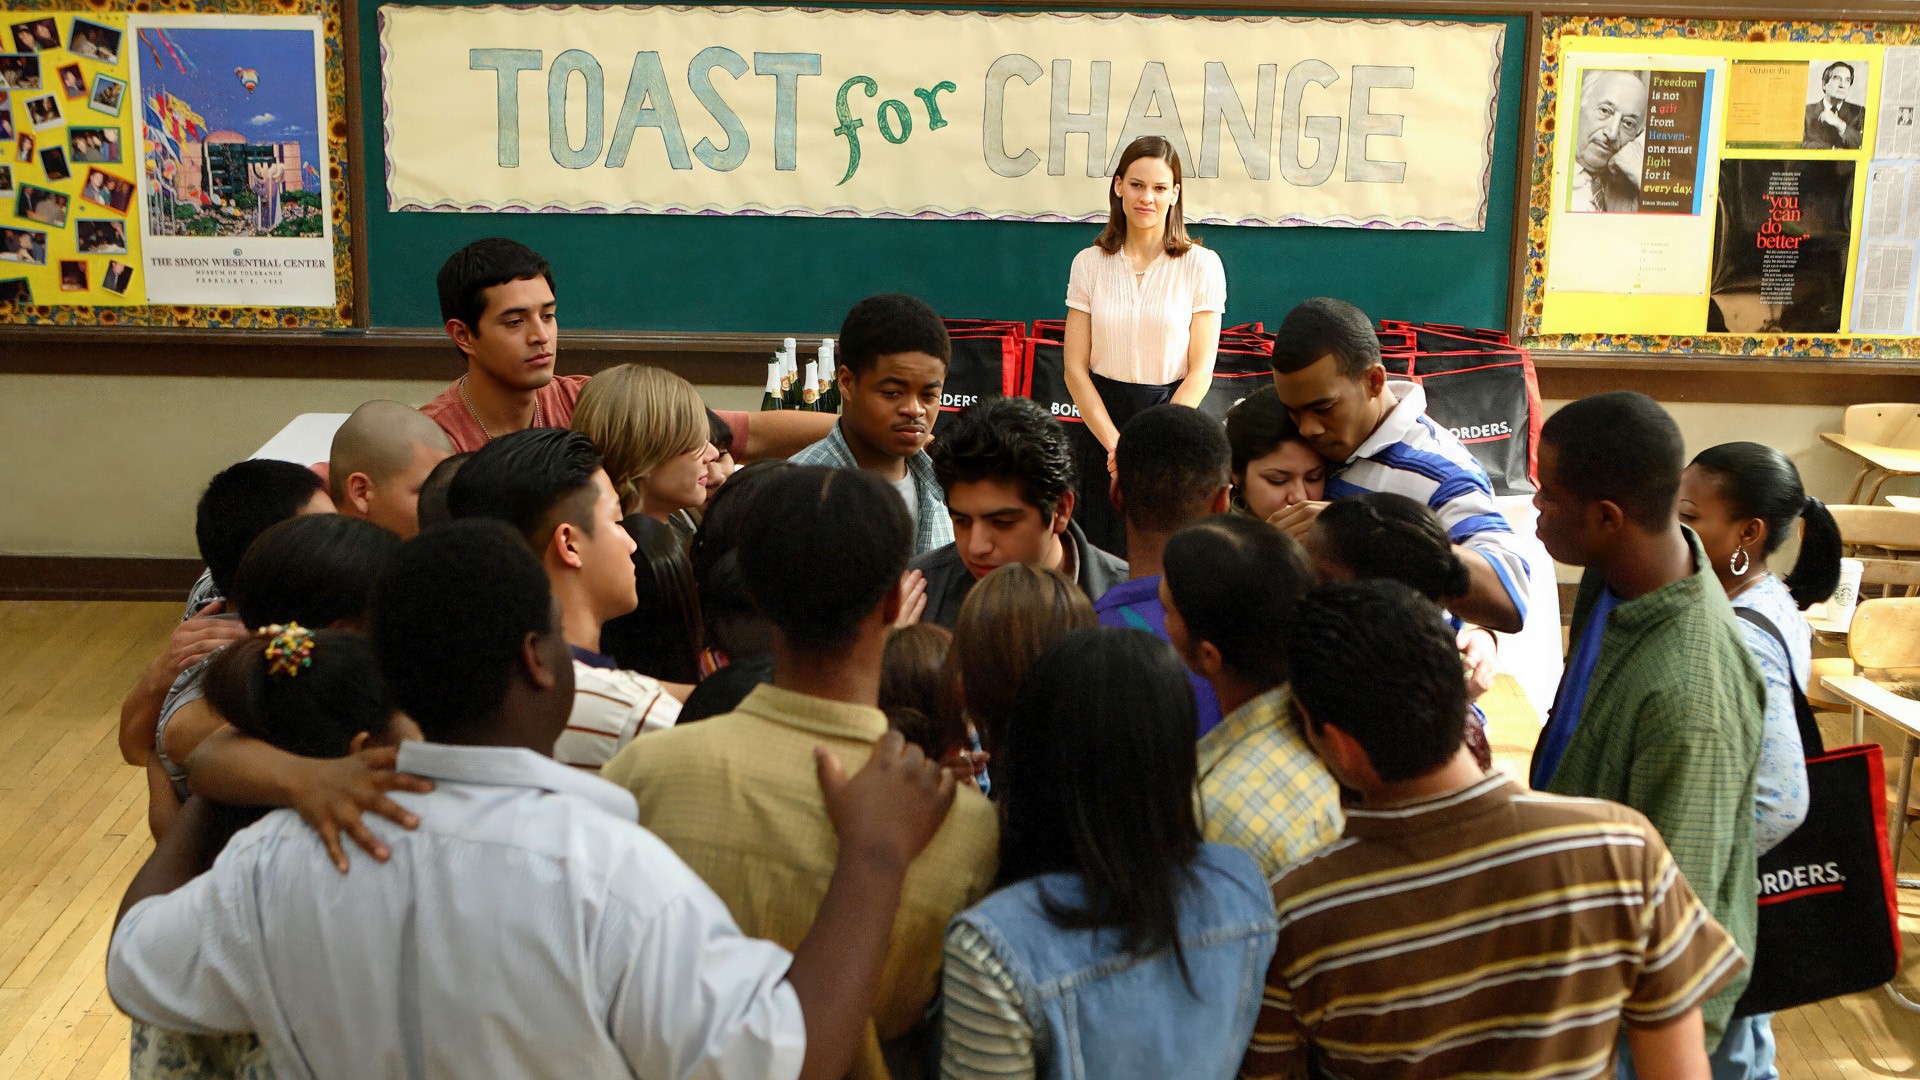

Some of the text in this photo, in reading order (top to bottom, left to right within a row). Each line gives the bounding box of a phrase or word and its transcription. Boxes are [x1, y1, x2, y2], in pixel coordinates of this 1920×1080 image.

[1653, 76, 1697, 88] Freedom
[1652, 90, 1680, 101] is not
[1651, 103, 1677, 115] a gift
[470, 46, 1415, 187] TOAST for CHANGE
[1649, 116, 1675, 127] from
[1647, 145, 1692, 155] one must
[1646, 156, 1671, 168] fight
[1645, 170, 1670, 180] for it
[1643, 182, 1692, 195] every day.
[1772, 209, 1801, 222] can
[1761, 217, 1782, 235] do
[151, 257, 326, 269] THE SIMON WIESENTHAL CENTER
[1449, 421, 1513, 439] ORDERS.
[1756, 861, 1846, 895] RDERS.
